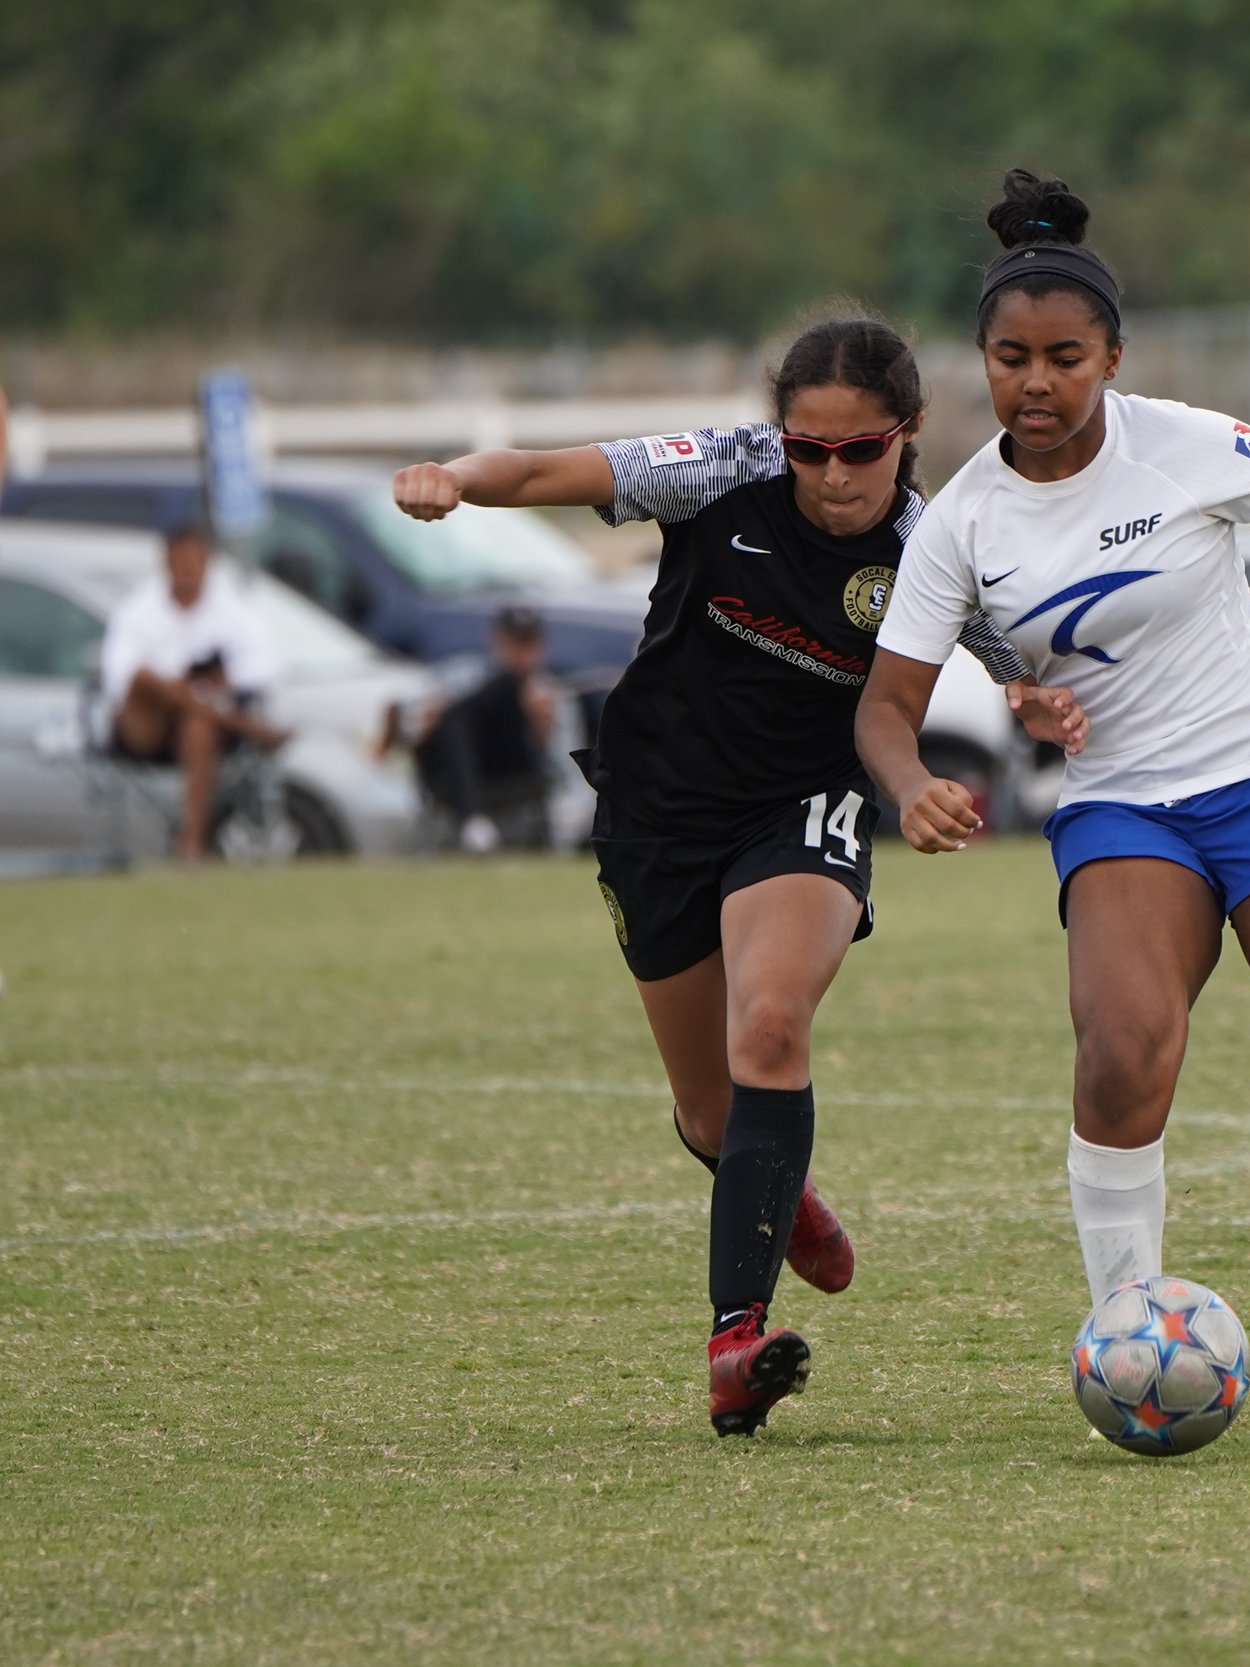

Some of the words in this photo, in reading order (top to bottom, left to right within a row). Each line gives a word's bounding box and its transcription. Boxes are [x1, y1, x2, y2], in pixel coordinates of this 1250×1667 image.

[1099, 512, 1163, 551] SURF
[855, 568, 886, 582] SOCAL
[707, 602, 867, 687] TRANSMISSION
[711, 596, 867, 673] California
[800, 790, 864, 863] 14
